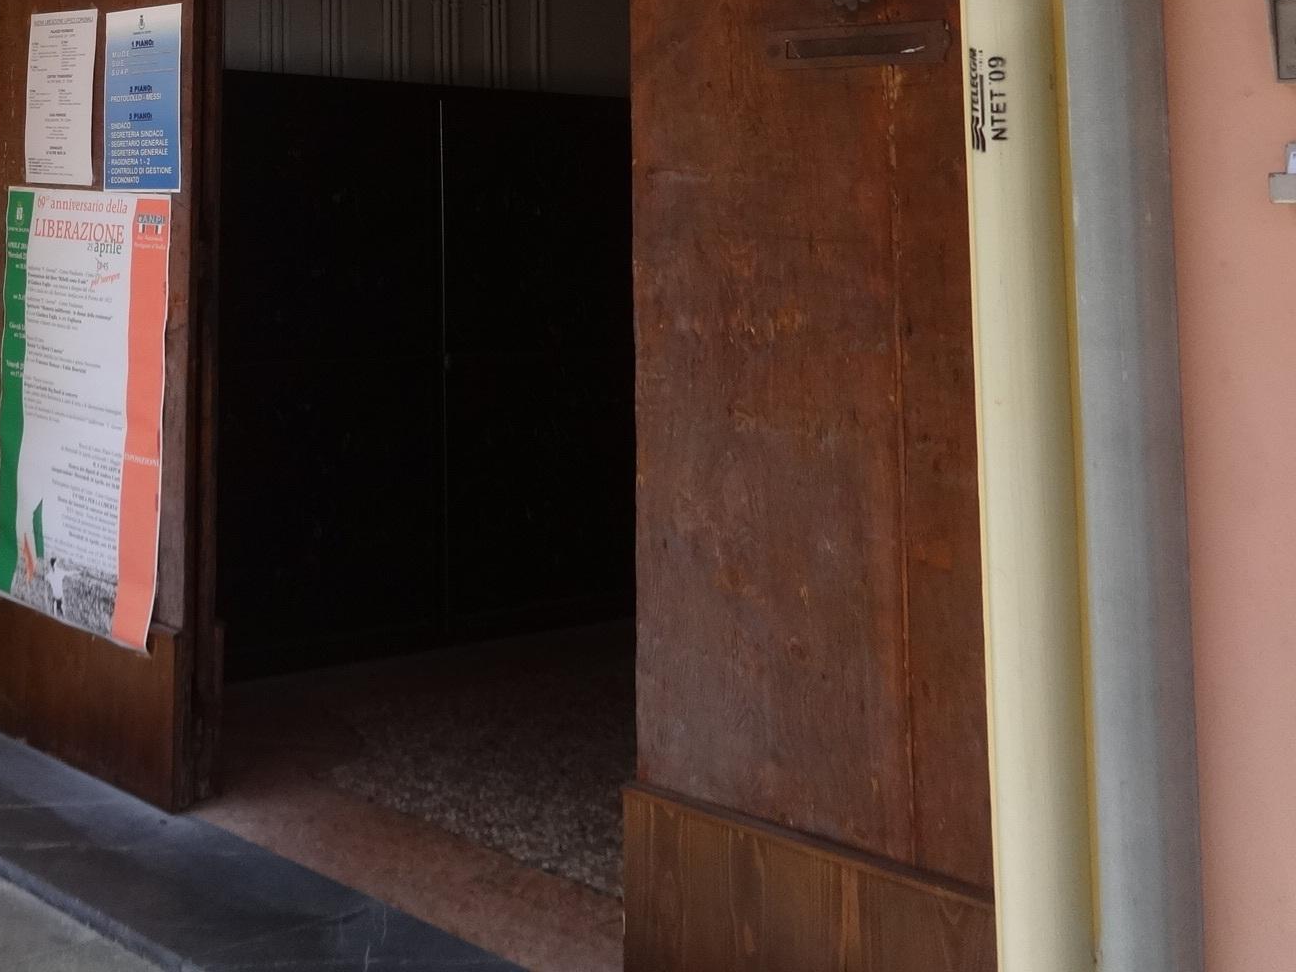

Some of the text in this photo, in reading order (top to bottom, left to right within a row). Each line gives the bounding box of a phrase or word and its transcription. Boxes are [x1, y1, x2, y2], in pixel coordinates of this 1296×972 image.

[969, 48, 980, 113] TELECOM
[989, 89, 1008, 141] NTET
[50, 198, 104, 214] anniversario
[105, 199, 128, 214] della
[34, 217, 125, 245] LIBERAZIONE
[94, 238, 122, 258] aprile
